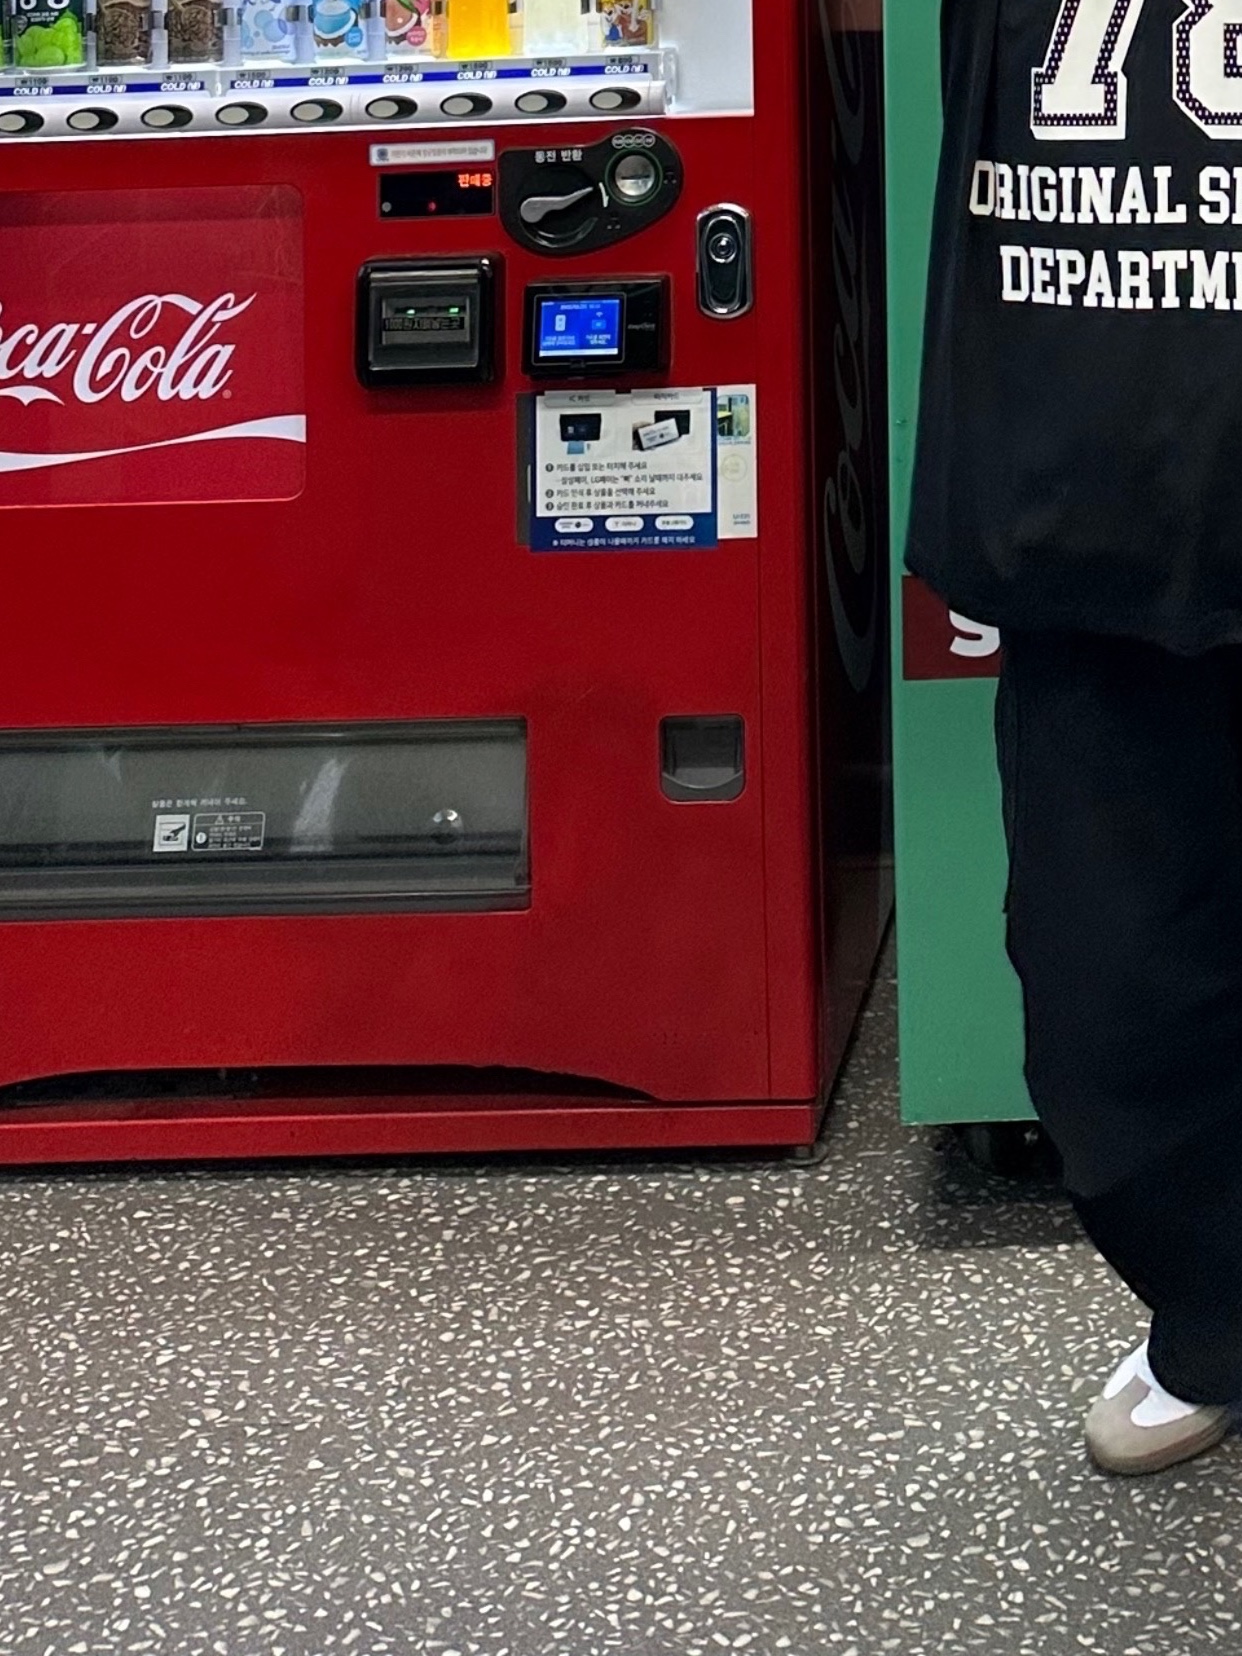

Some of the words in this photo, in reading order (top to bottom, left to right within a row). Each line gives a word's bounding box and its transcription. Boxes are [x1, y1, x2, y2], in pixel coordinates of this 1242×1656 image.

[457, 71, 482, 80] COLD
[308, 77, 334, 86] COLD
[13, 86, 38, 95] COLD
[87, 85, 112, 94] COLD
[969, 160, 1187, 225] ORIGINAL
[0, 292, 257, 404] ca-Cola
